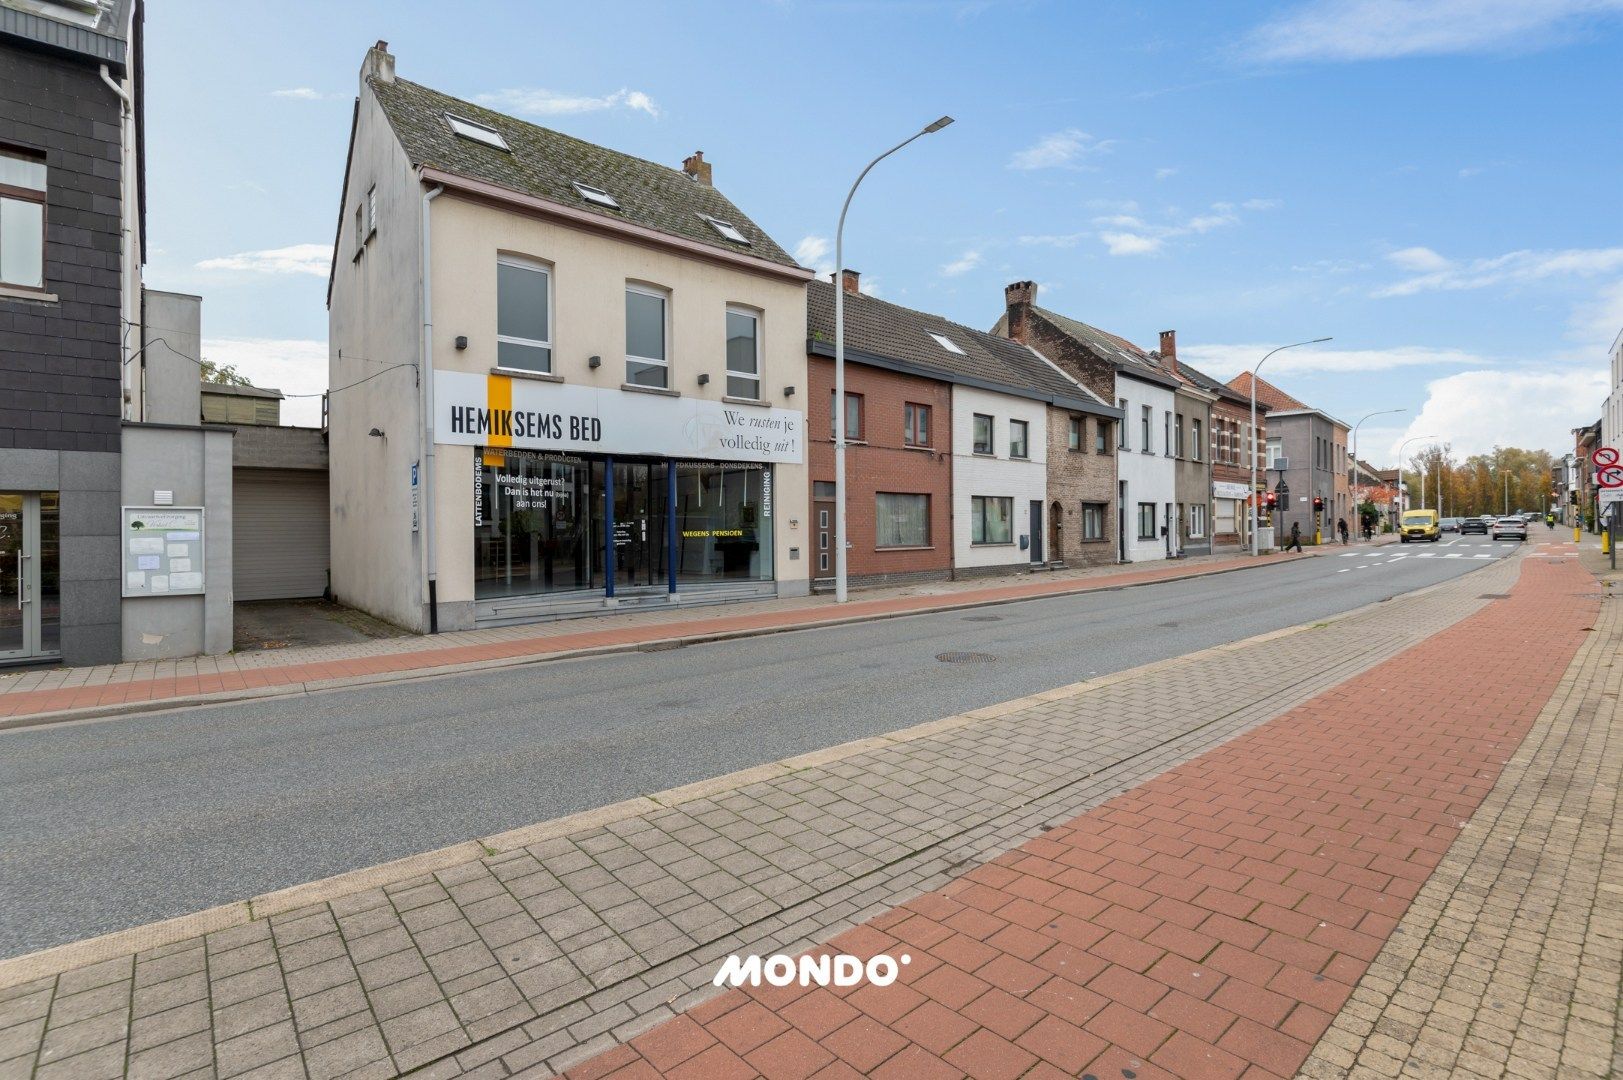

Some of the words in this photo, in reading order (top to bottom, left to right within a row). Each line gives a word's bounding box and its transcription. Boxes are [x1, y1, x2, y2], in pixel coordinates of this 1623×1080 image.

[451, 405, 562, 440] HEMIKSEMS
[569, 415, 601, 442] BED
[724, 410, 745, 426] We
[749, 417, 780, 430] rusten
[784, 416, 794, 434] je
[719, 434, 771, 455] volledig
[483, 448, 537, 460] WATERBEDDEN
[544, 453, 582, 463] PRODUCTEN
[720, 462, 763, 470] DONSDEKENS
[495, 474, 527, 485] Volledig
[529, 476, 565, 487] uitgerust?
[475, 457, 483, 527] LATTENBODEMS
[504, 486, 521, 496] Dan
[522, 487, 529, 496] is
[530, 487, 543, 497] het
[544, 489, 554, 497] nu
[763, 471, 771, 517] REINIGING
[516, 500, 530, 508] aan
[531, 500, 547, 509] ons!
[682, 530, 710, 538] WEGENS
